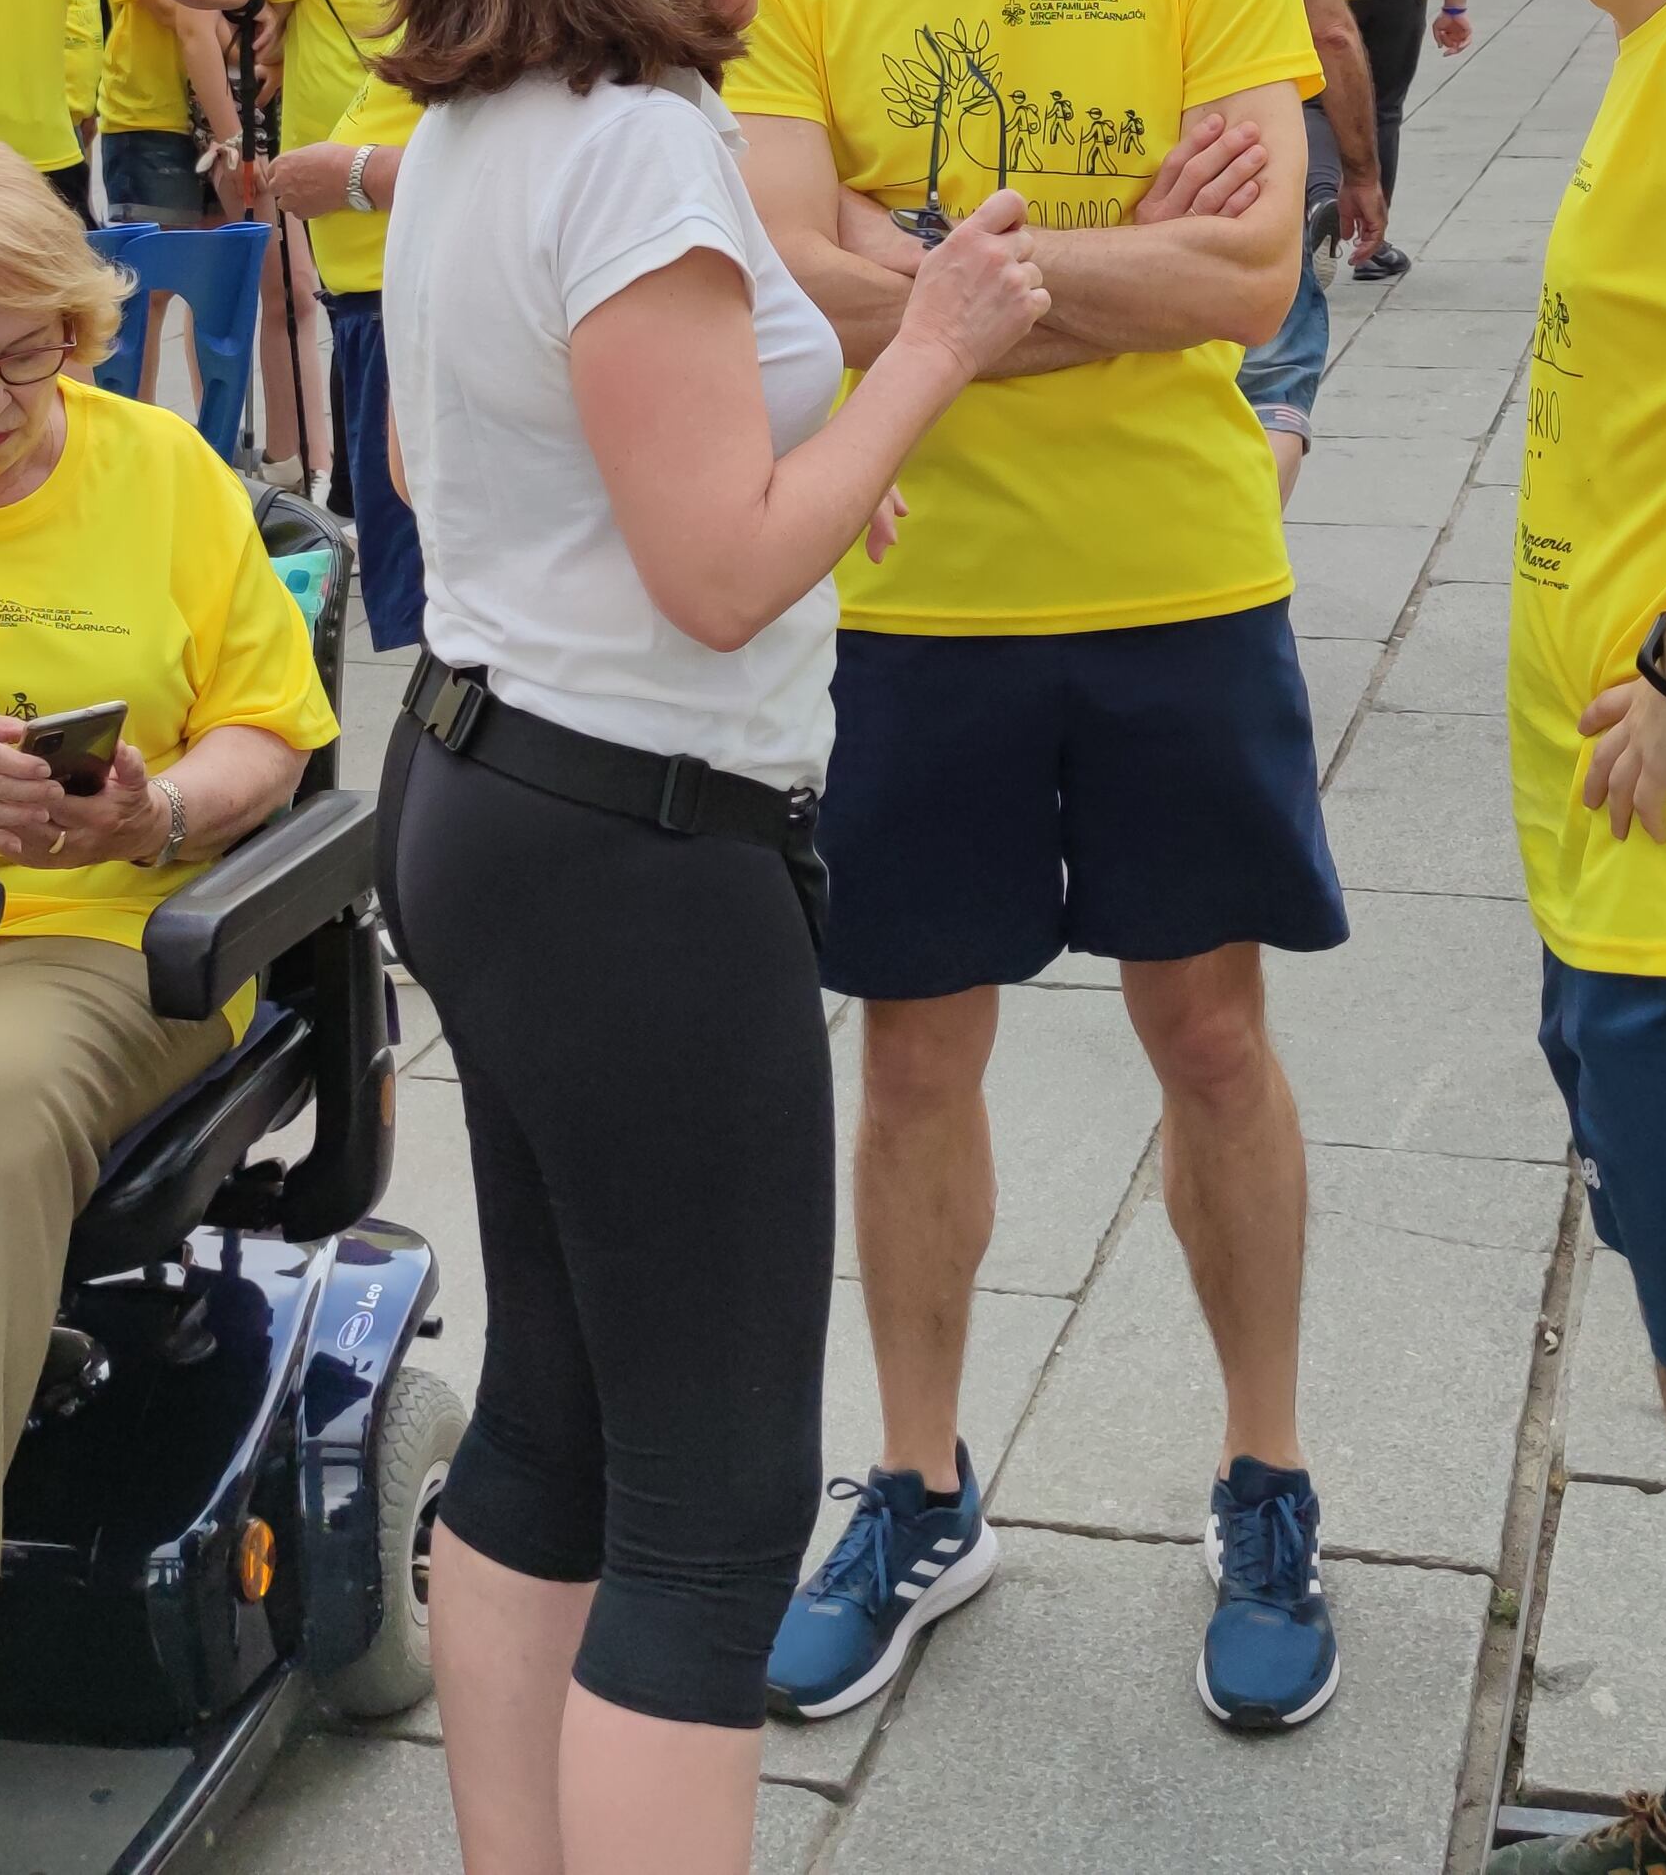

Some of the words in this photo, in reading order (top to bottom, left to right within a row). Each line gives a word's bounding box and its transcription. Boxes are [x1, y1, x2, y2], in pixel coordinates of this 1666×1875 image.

[1029, 2, 1055, 11] CASA
[1056, 2, 1100, 11] FAMILIAR
[1029, 11, 1064, 21] VIRGEN
[1026, 198, 1122, 230] OLIDARIO
[55, 622, 130, 636] ENCARNACIÓN
[356, 1283, 383, 1309] Leo
